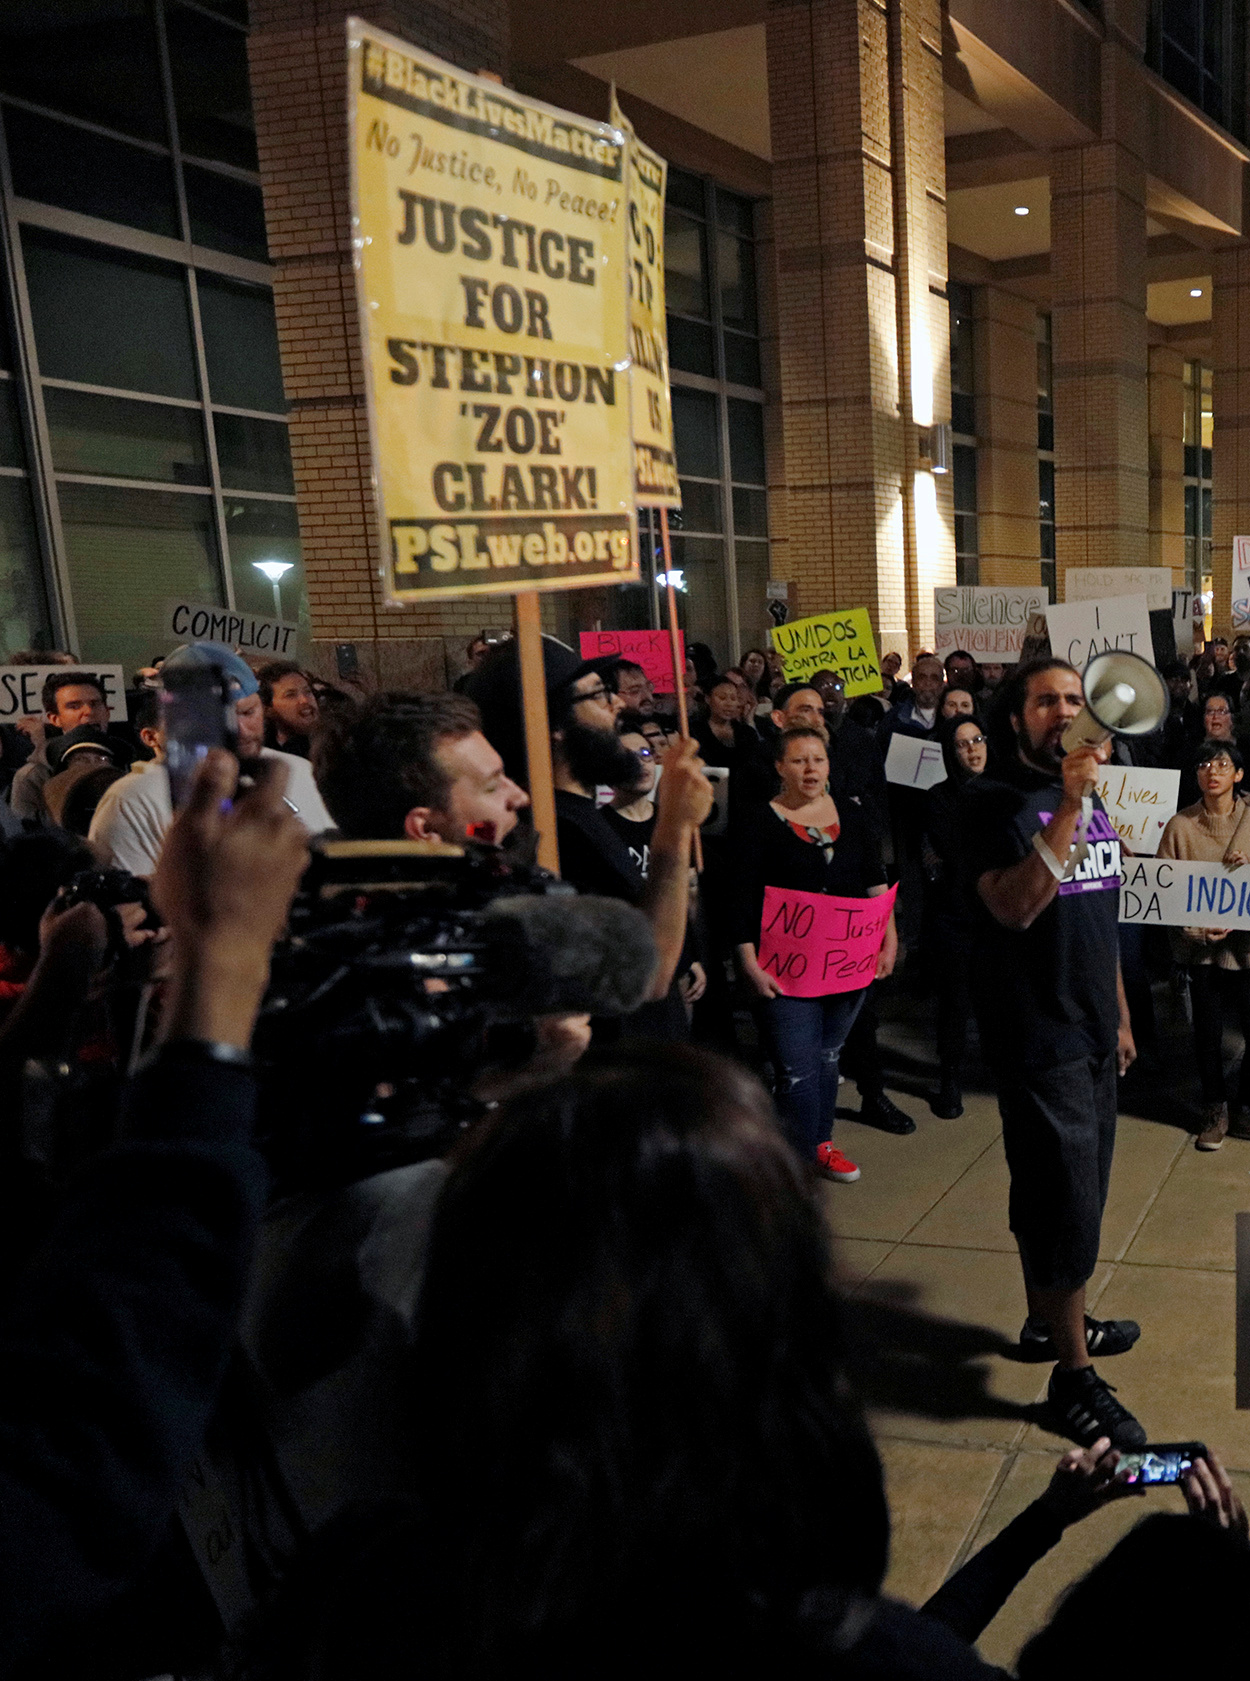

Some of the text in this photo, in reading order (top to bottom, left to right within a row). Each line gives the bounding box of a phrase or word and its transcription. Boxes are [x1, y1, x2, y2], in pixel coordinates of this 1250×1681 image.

[366, 40, 619, 167] #BlackLivesMatter
[366, 118, 620, 223] No Justice, No Peace!
[397, 189, 595, 287] JUSTICE
[460, 275, 553, 341] FOR
[386, 337, 616, 406] STEPHON
[460, 404, 566, 457] 'ZOE'
[432, 461, 597, 512] CLARK!
[391, 523, 631, 574] PSLweb.org
[937, 587, 1041, 625] Silence
[1095, 606, 1101, 630] I
[172, 605, 296, 652] COMPLICIT
[597, 633, 661, 655] Black
[777, 619, 857, 654] UNIDOS
[782, 646, 867, 673] CONTRA LA
[913, 747, 941, 783] F
[1116, 773, 1167, 810] Lives
[1060, 840, 1121, 883] LACK
[766, 902, 815, 938] NO
[1124, 891, 1162, 921] DA
[762, 952, 807, 979] NO
